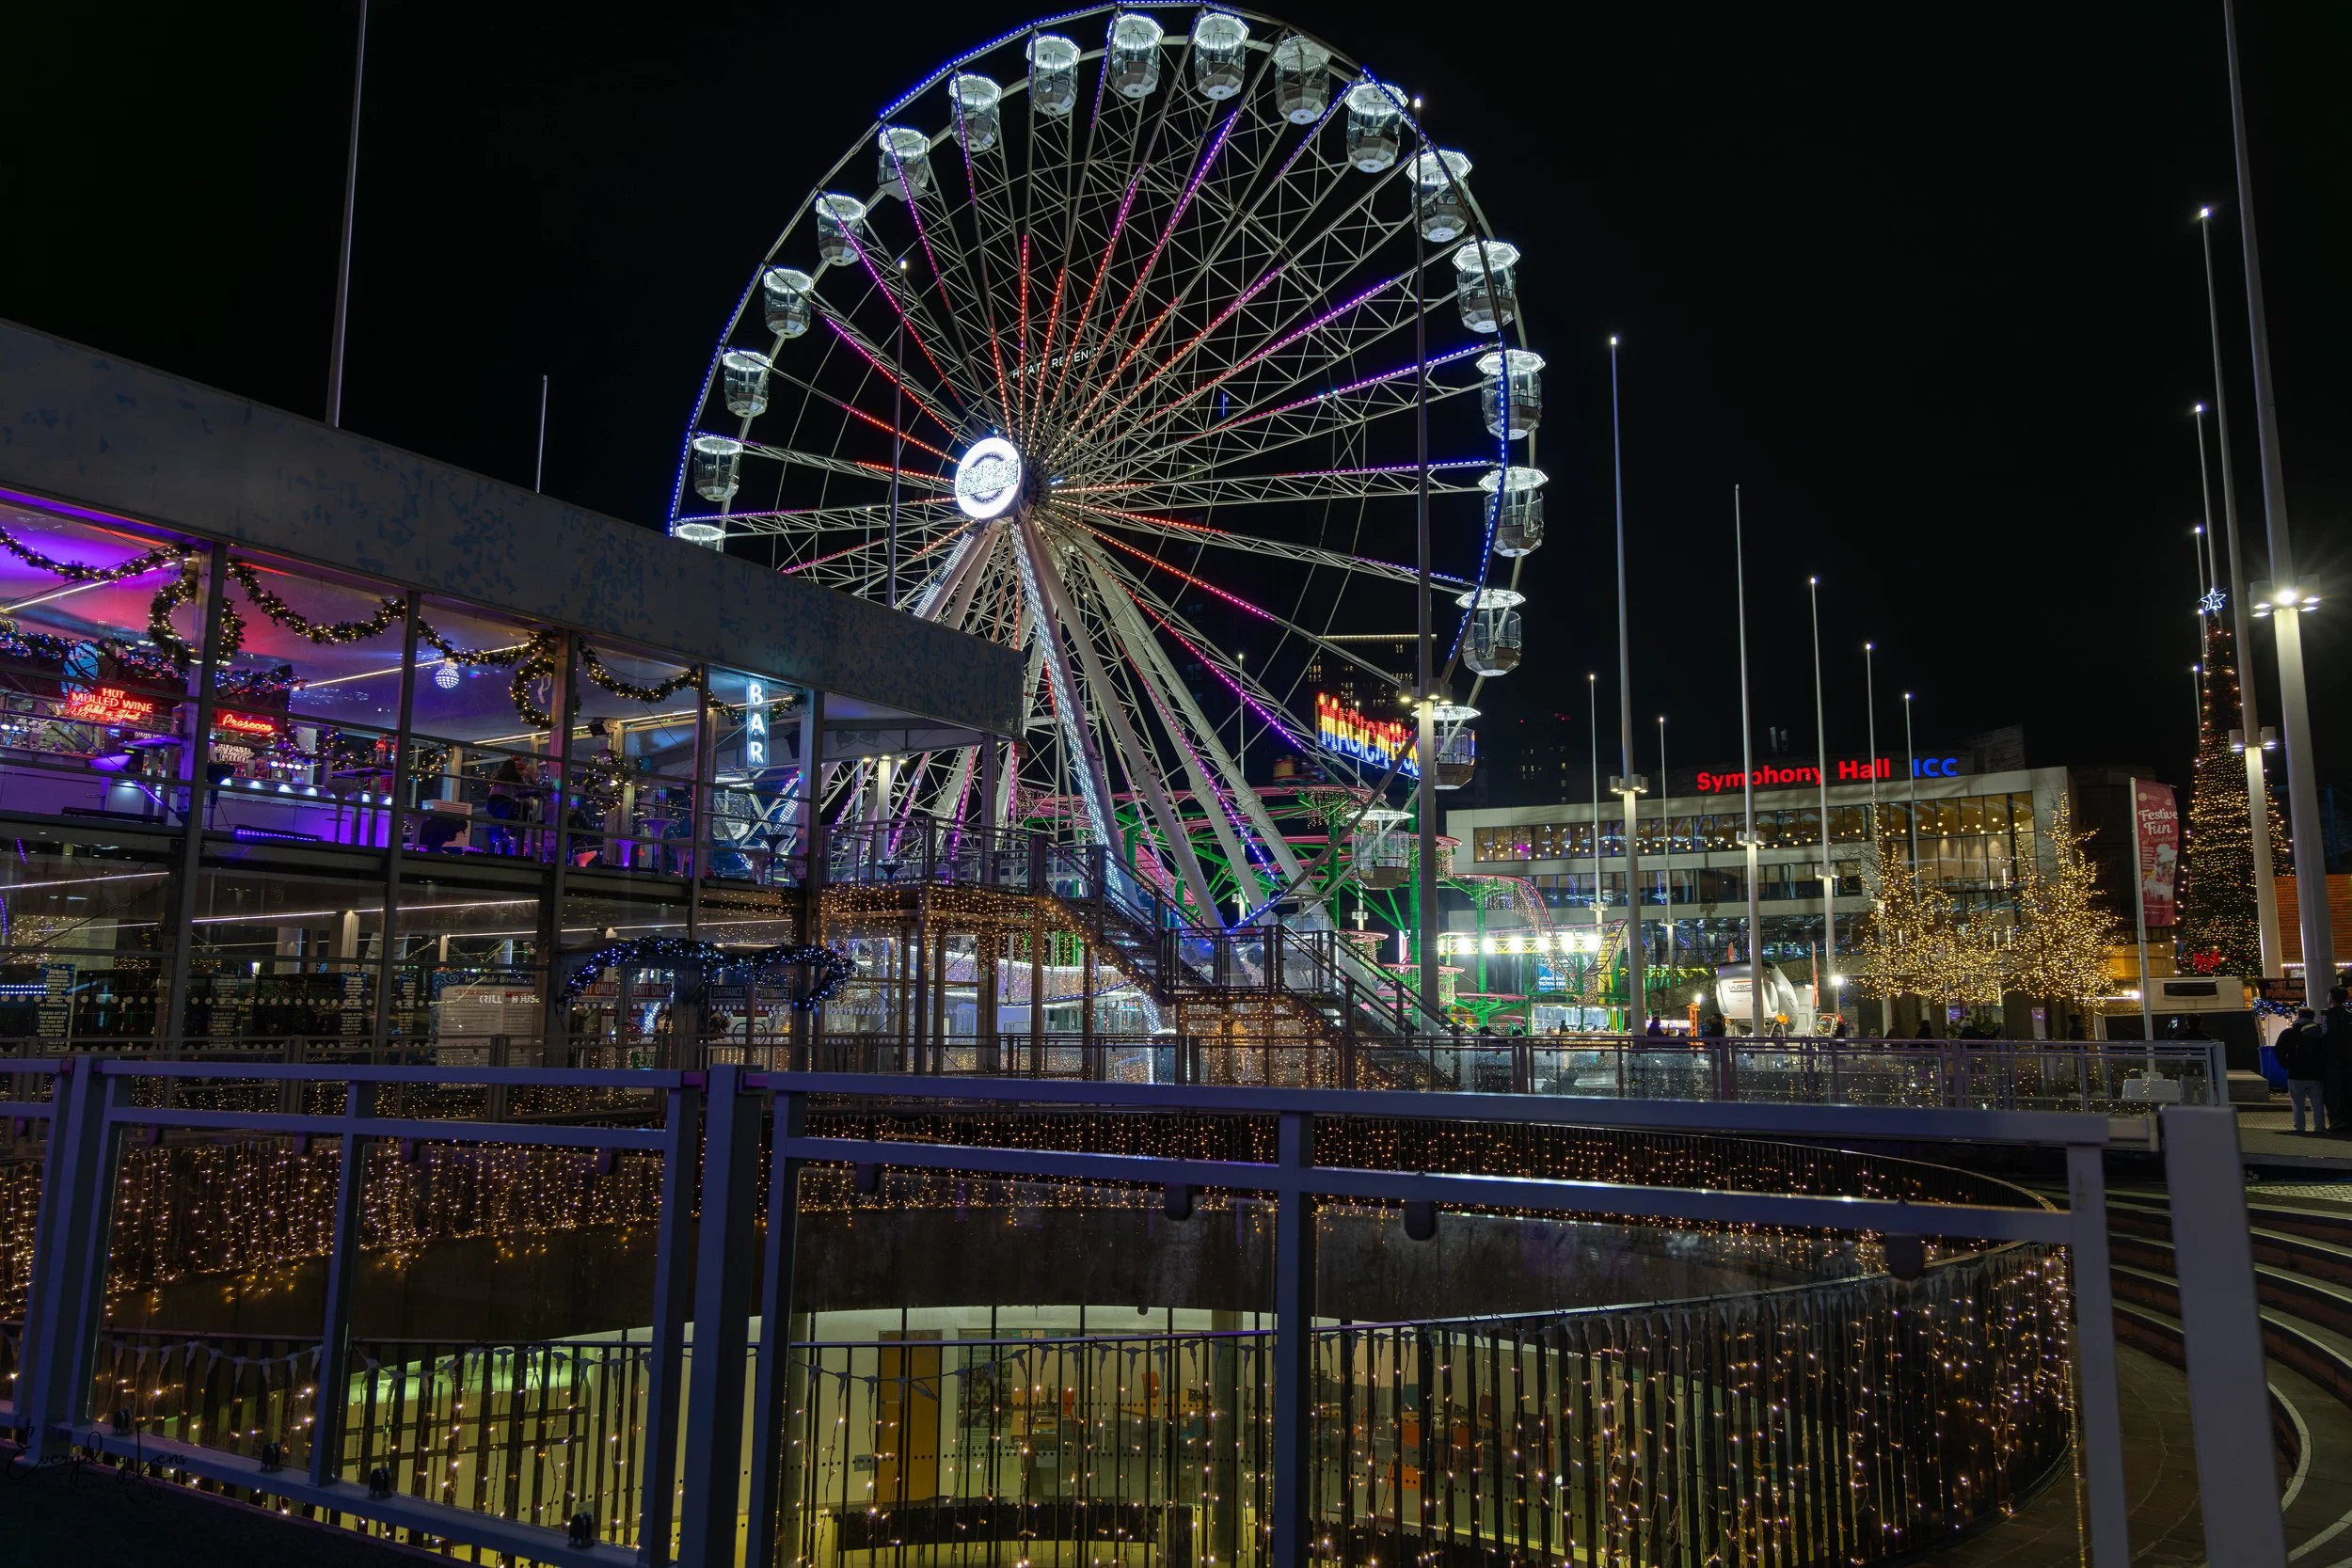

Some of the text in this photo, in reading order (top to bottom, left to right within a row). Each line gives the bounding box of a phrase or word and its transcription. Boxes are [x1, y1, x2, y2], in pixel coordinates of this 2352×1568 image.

[72, 692, 152, 712] MULLED WINE
[84, 704, 105, 715] Add
[119, 709, 141, 721] Shot
[222, 713, 273, 732] Prosecco
[749, 684, 765, 764] BAR
[1318, 693, 1376, 763] MAGIC
[1696, 758, 1890, 793] Symphony Hall
[1914, 757, 1958, 777] ICC
[2138, 807, 2178, 822] Festive
[2143, 821, 2172, 835] Fun
[465, 974, 475, 983] Ice
[596, 983, 616, 994] ONLY
[633, 984, 672, 996] EXIT ONLY
